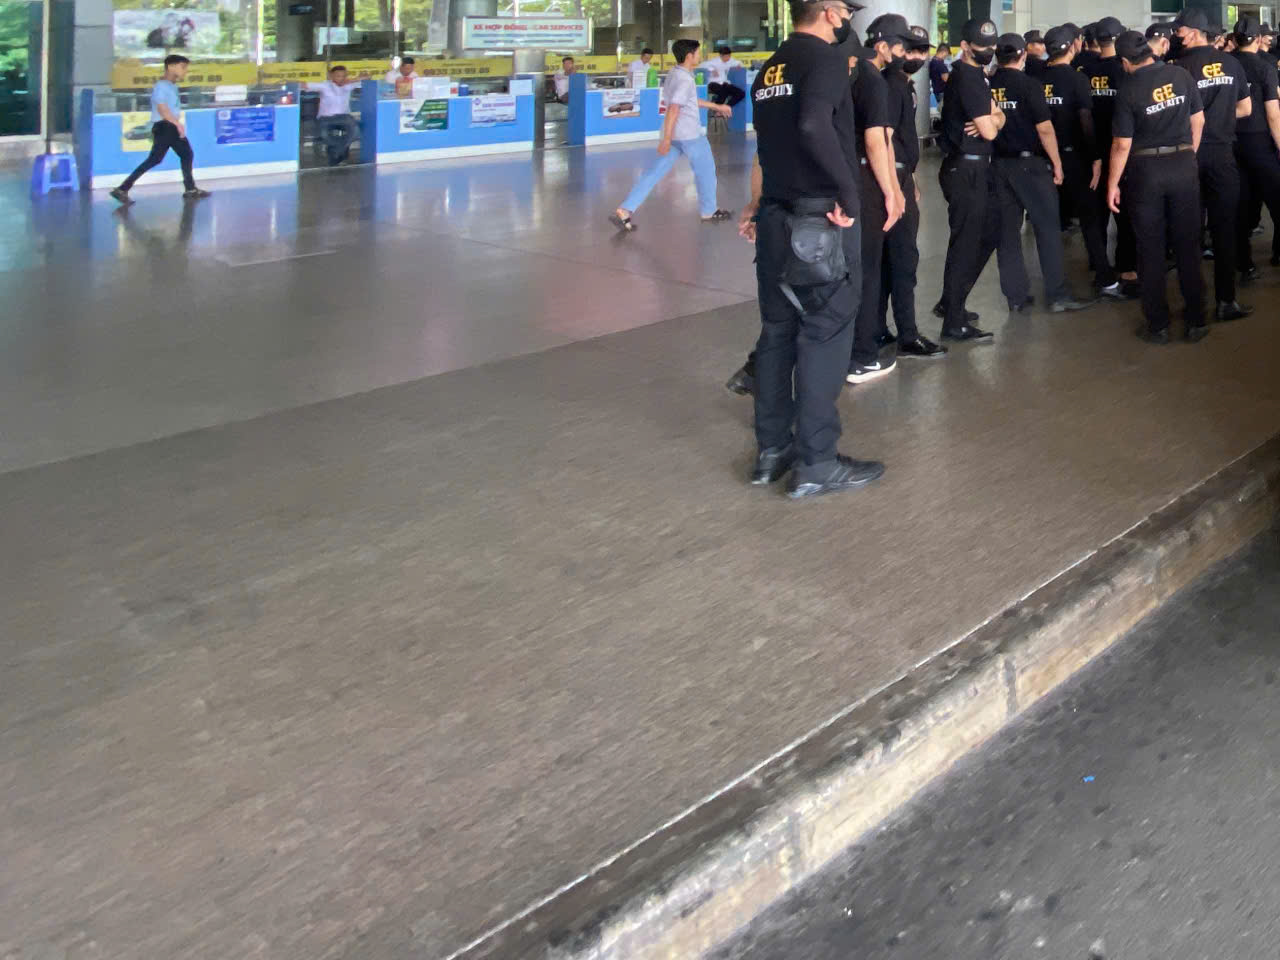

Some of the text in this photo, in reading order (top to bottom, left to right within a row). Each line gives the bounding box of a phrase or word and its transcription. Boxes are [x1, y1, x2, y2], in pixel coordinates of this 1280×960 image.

[1201, 63, 1225, 78] GE
[1090, 76, 1109, 89] GE
[1197, 76, 1234, 89] SECURITY
[1152, 83, 1176, 102] GE
[1146, 95, 1186, 115] SECURITY
